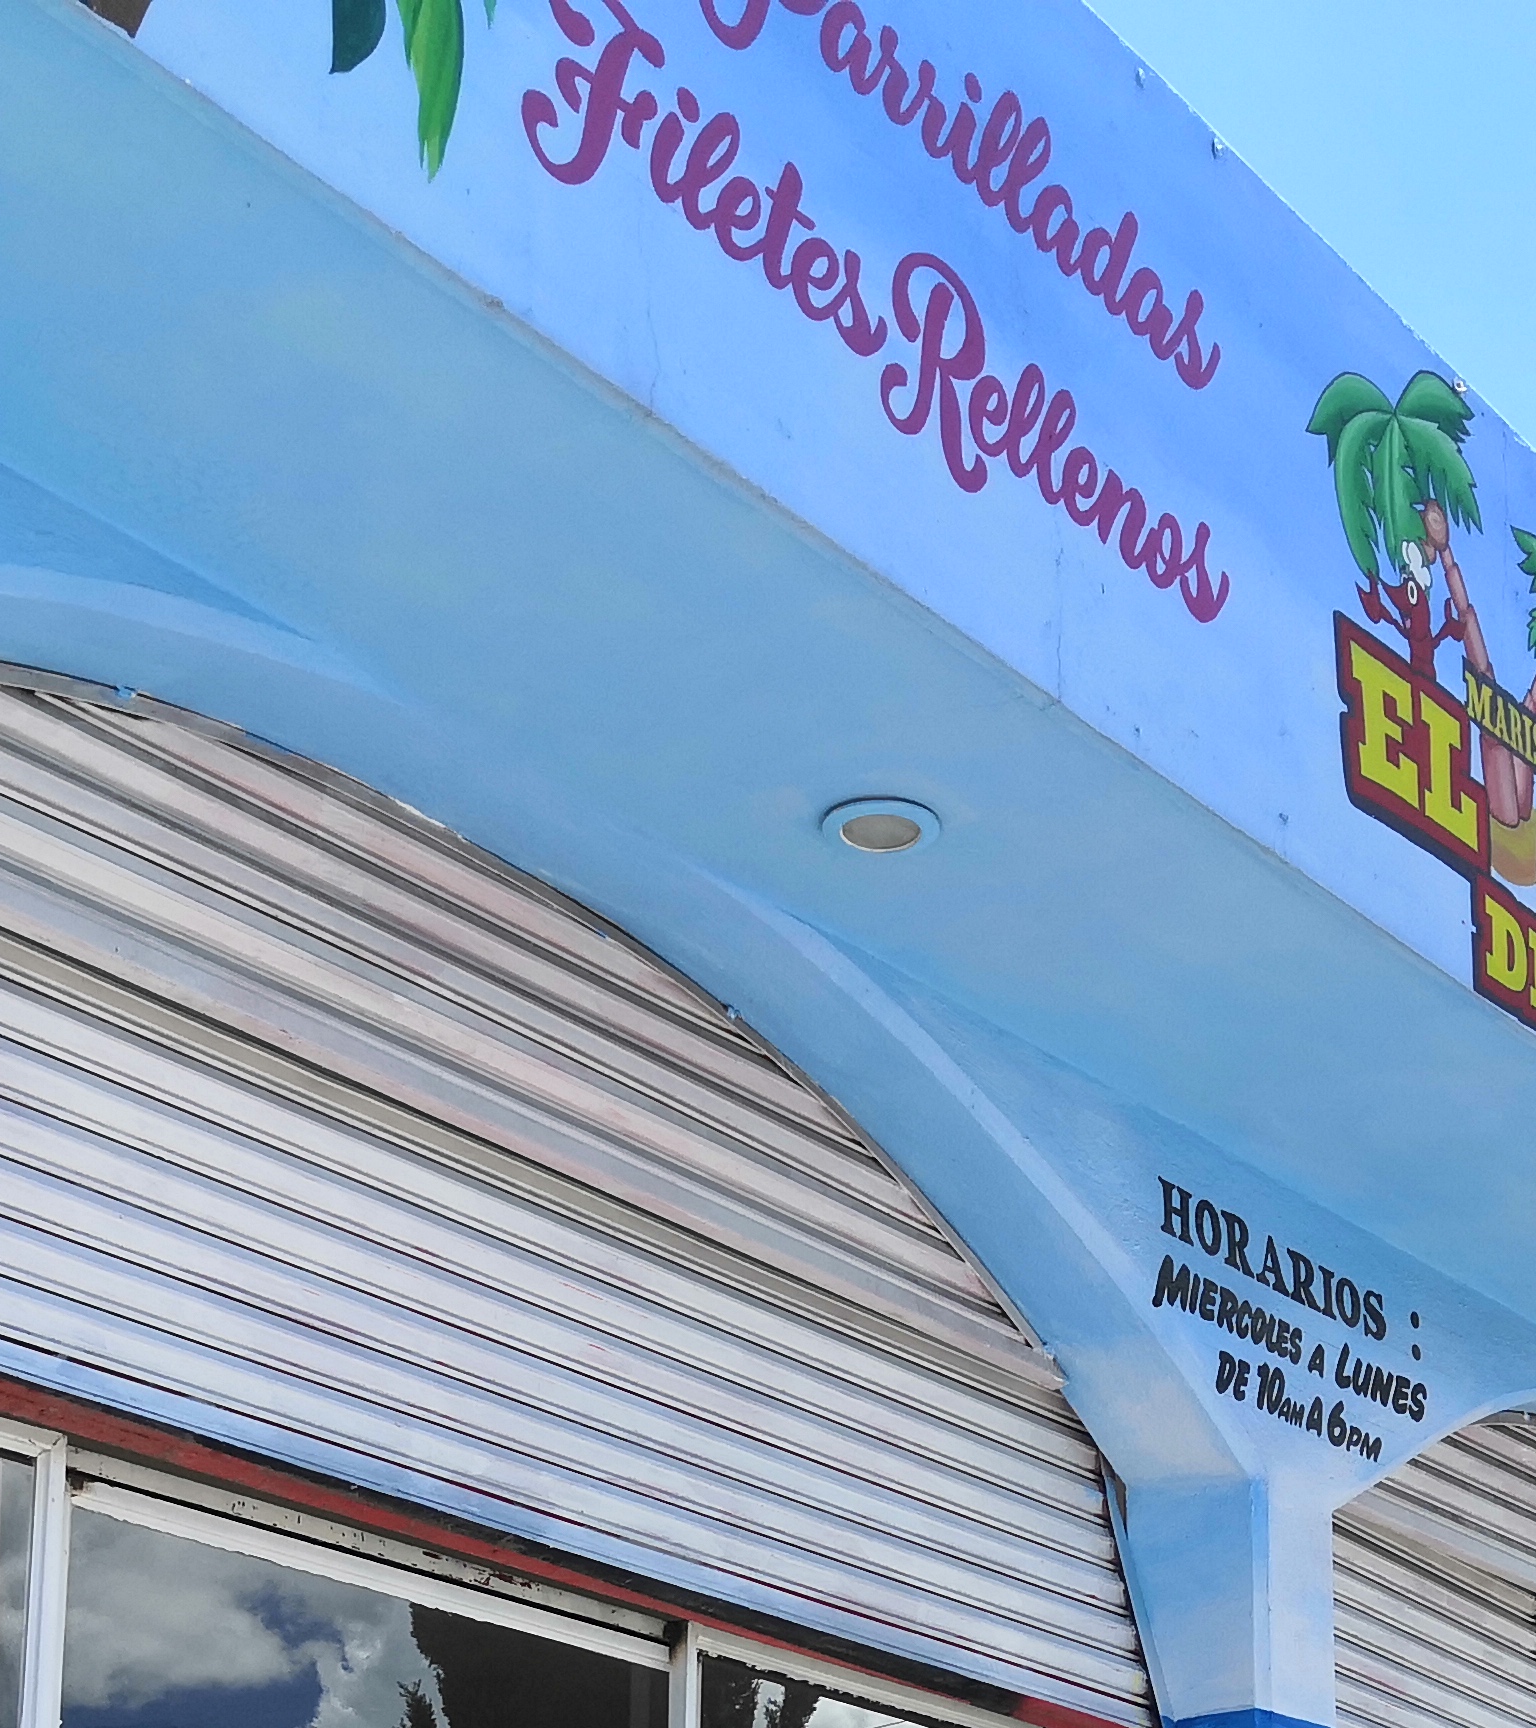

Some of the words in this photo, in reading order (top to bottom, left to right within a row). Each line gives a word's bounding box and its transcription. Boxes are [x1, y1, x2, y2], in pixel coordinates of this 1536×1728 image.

[521, 0, 885, 357] Filetes
[881, 251, 1231, 624] Rellenos
[1349, 639, 1481, 852] EL
[1151, 1254, 1303, 1367] MIERCOLES
[1307, 1343, 1325, 1379] A
[1334, 1342, 1428, 1423] LUNES
[1157, 1174, 1388, 1341] HORARIOS
[1214, 1349, 1250, 1402] DE
[1305, 1395, 1324, 1438] A
